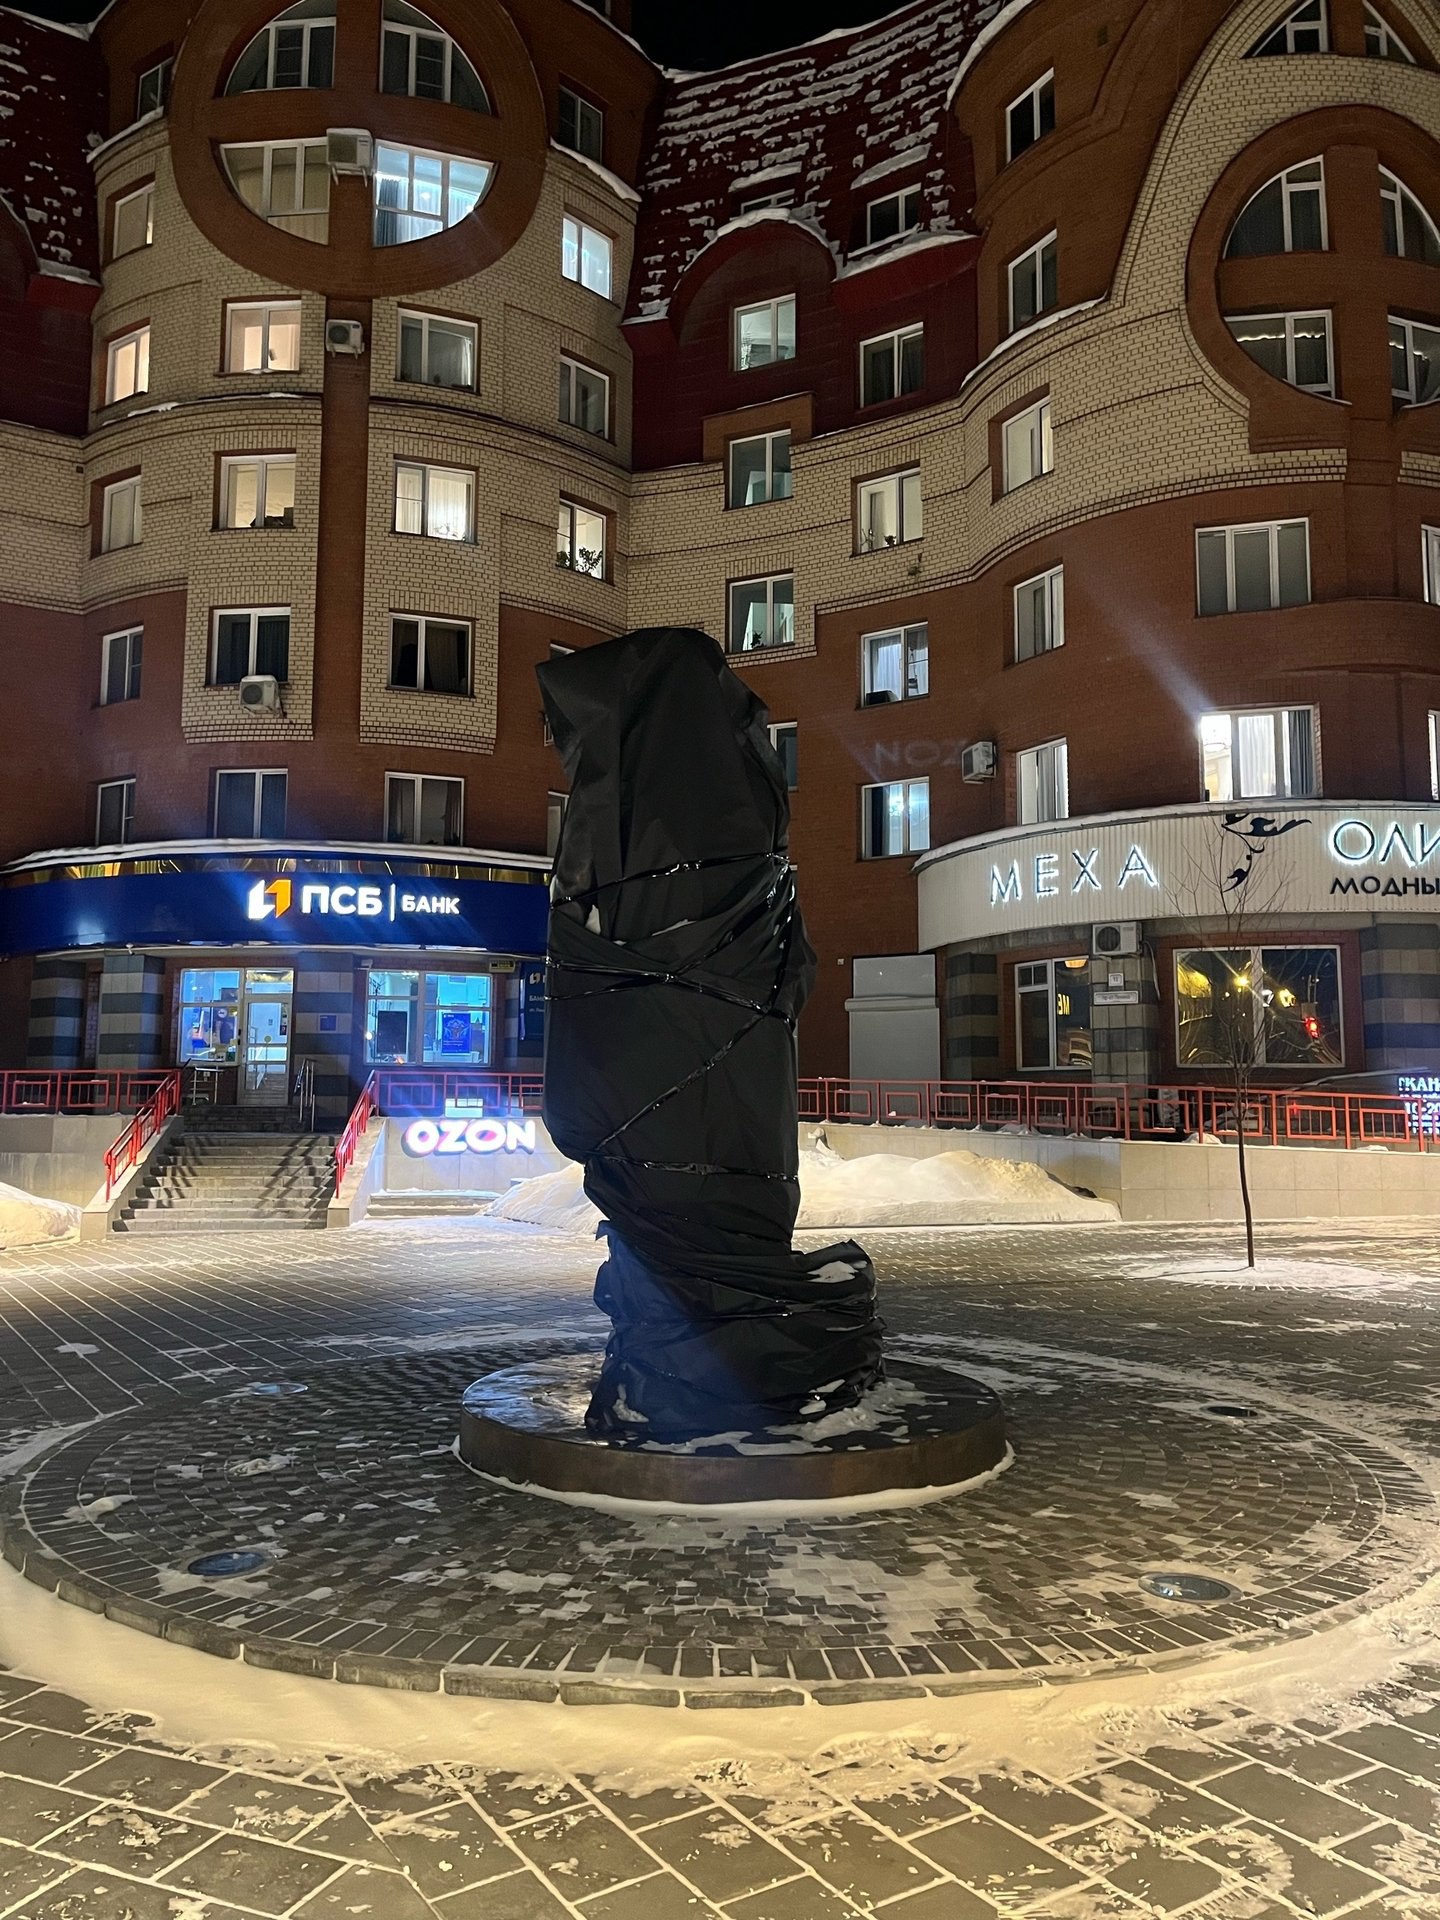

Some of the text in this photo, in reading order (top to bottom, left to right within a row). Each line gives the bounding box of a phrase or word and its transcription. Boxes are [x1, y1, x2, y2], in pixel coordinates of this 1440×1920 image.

[991, 845, 1158, 907] МЕХА
[1330, 875, 1440, 897] МОДНЫ
[301, 885, 460, 916] ПСБ БАНК
[402, 1118, 536, 1156] OZON
